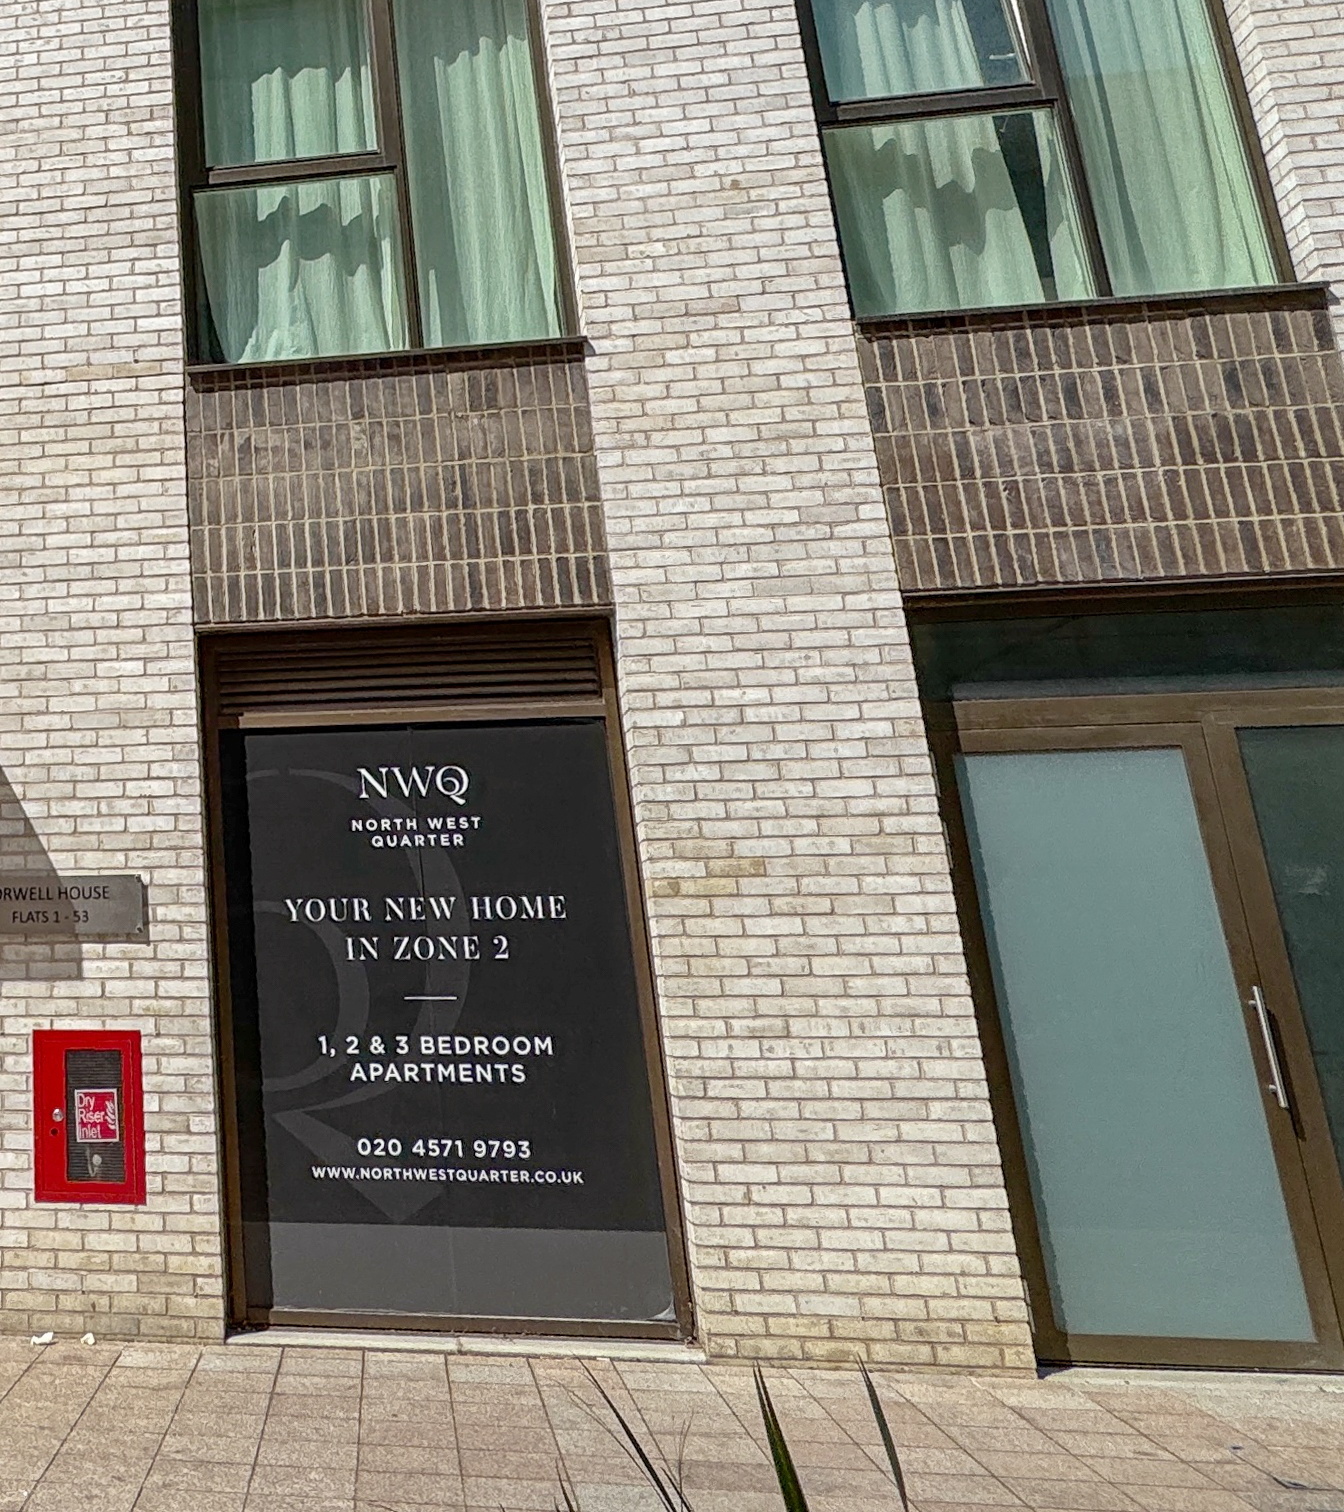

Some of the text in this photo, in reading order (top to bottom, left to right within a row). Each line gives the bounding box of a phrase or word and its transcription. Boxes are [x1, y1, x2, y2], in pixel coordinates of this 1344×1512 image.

[356, 765, 470, 805] NWQ
[351, 816, 482, 832] NORTH WEST
[371, 834, 465, 848] QUARTER
[57, 885, 111, 900] HOUSE
[12, 910, 49, 924] FLATS
[53, 911, 61, 923] 1
[73, 910, 90, 923] 53
[285, 895, 568, 922] YOUR NEW HOME
[345, 935, 510, 962] IN ZONE 2
[318, 1035, 554, 1058] 1, 2 & 3 BEDROOM
[349, 1062, 527, 1083] APARTMENTS
[77, 1093, 95, 1110] Dry
[78, 1108, 105, 1123] Riser
[79, 1123, 102, 1139] Inlet
[357, 1138, 532, 1159] 020 4571 9793
[311, 1165, 585, 1185] WWW.NORTHWESTQUARTER.CO.UK
